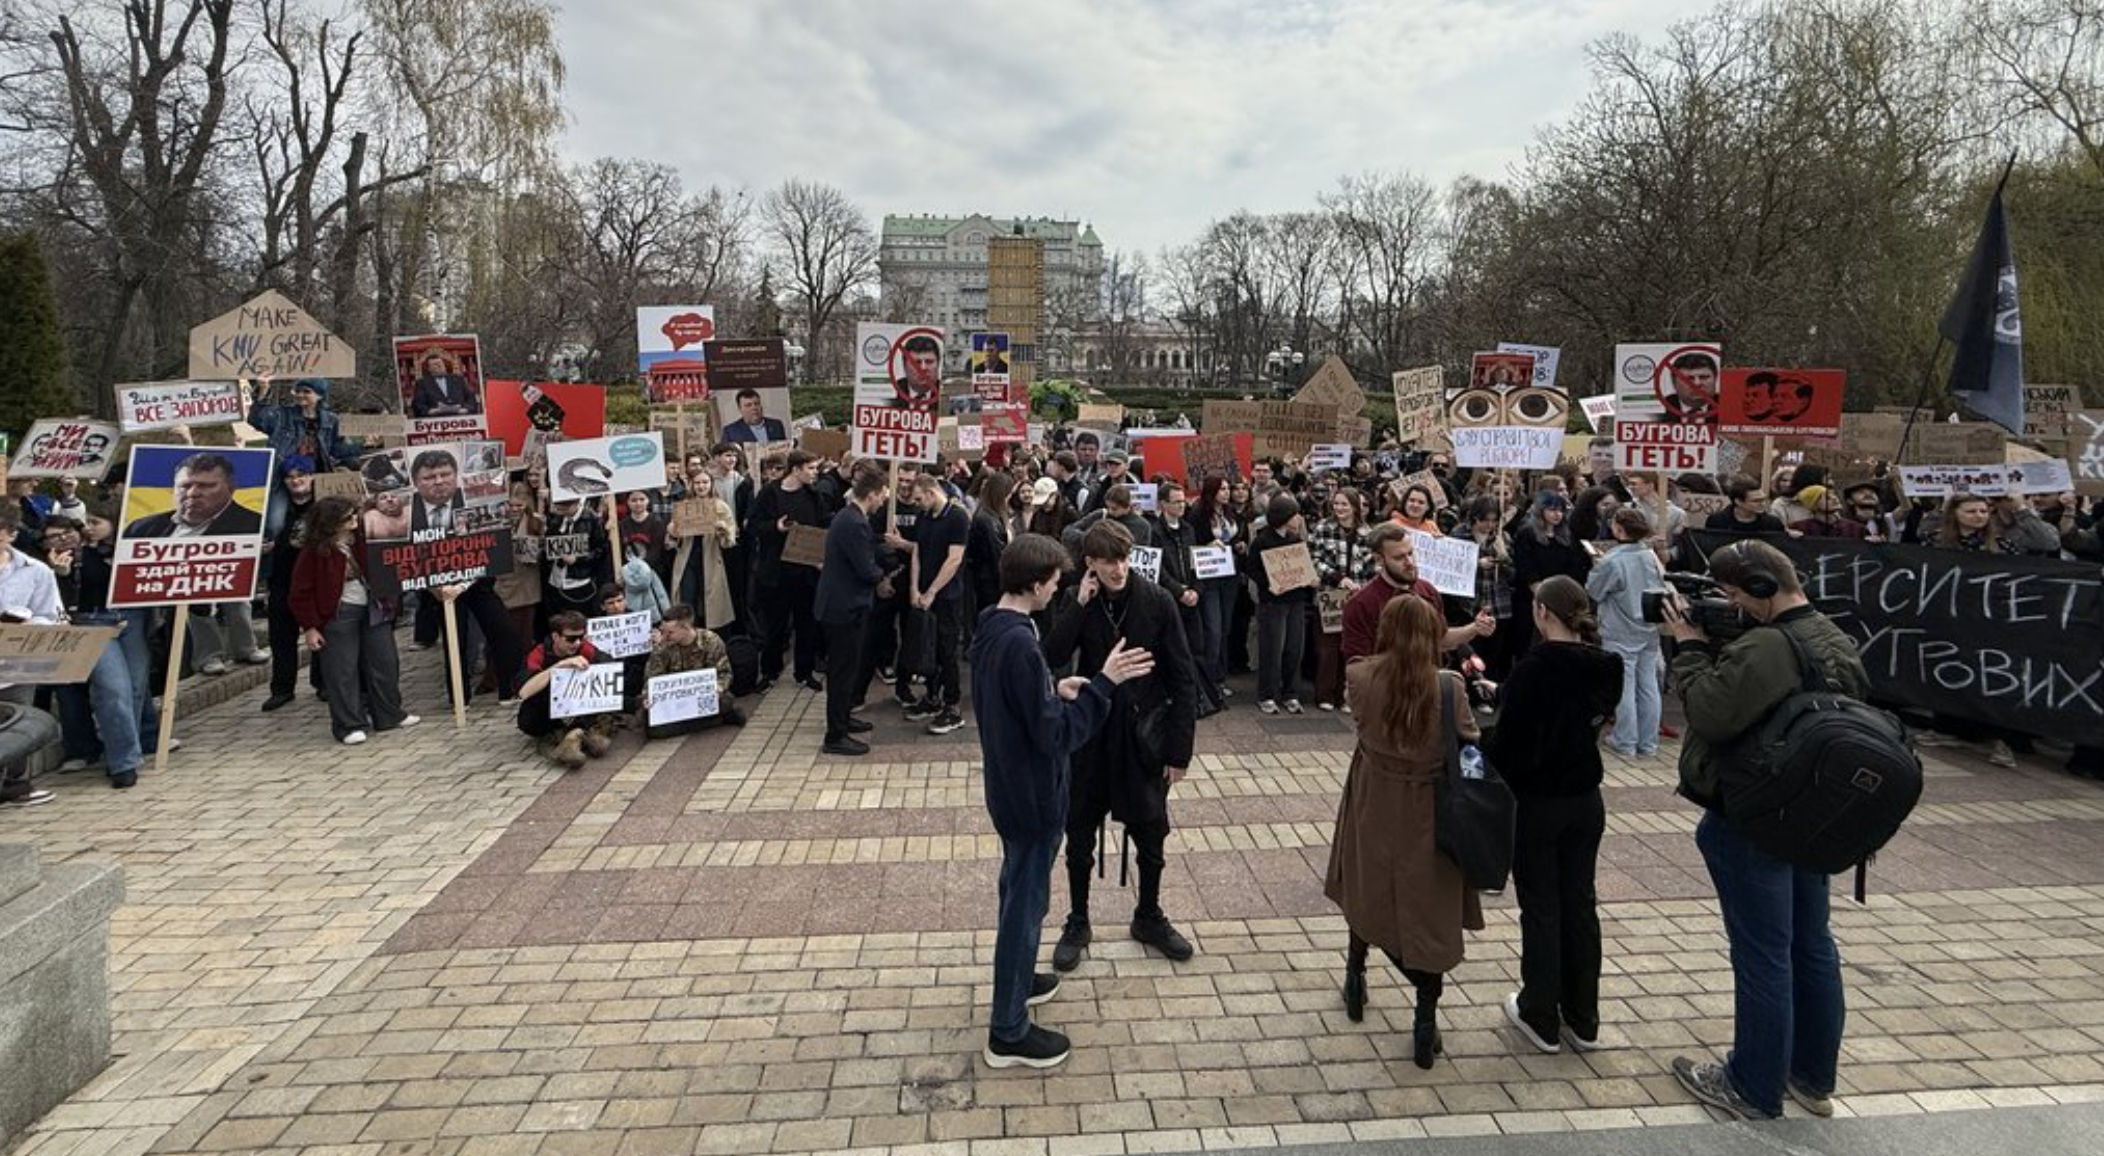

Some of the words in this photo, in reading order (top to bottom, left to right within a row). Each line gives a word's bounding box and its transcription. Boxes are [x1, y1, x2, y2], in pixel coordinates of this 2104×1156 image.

[239, 306, 298, 328] MAKE
[270, 333, 330, 356] GREAT
[238, 353, 320, 376] AGAIN!
[135, 403, 167, 422] ВСЕ
[859, 406, 932, 430] БУГРОВА
[414, 419, 478, 433] Бугрова
[1621, 422, 1711, 442] БУГРОВА
[861, 431, 928, 459] ГЕТЬ!
[1625, 445, 1706, 468] ГЕТЬ!
[413, 527, 446, 544] МОН
[131, 541, 236, 561] Бугров
[1129, 545, 1157, 565] TOP
[135, 562, 191, 580] здай
[193, 562, 241, 574] тест
[398, 549, 490, 580] БУГРОВА
[135, 581, 164, 594] на
[166, 574, 235, 598] ДНК
[401, 577, 427, 591] ВІД
[1798, 554, 2101, 629] ЕРСИТЕТ
